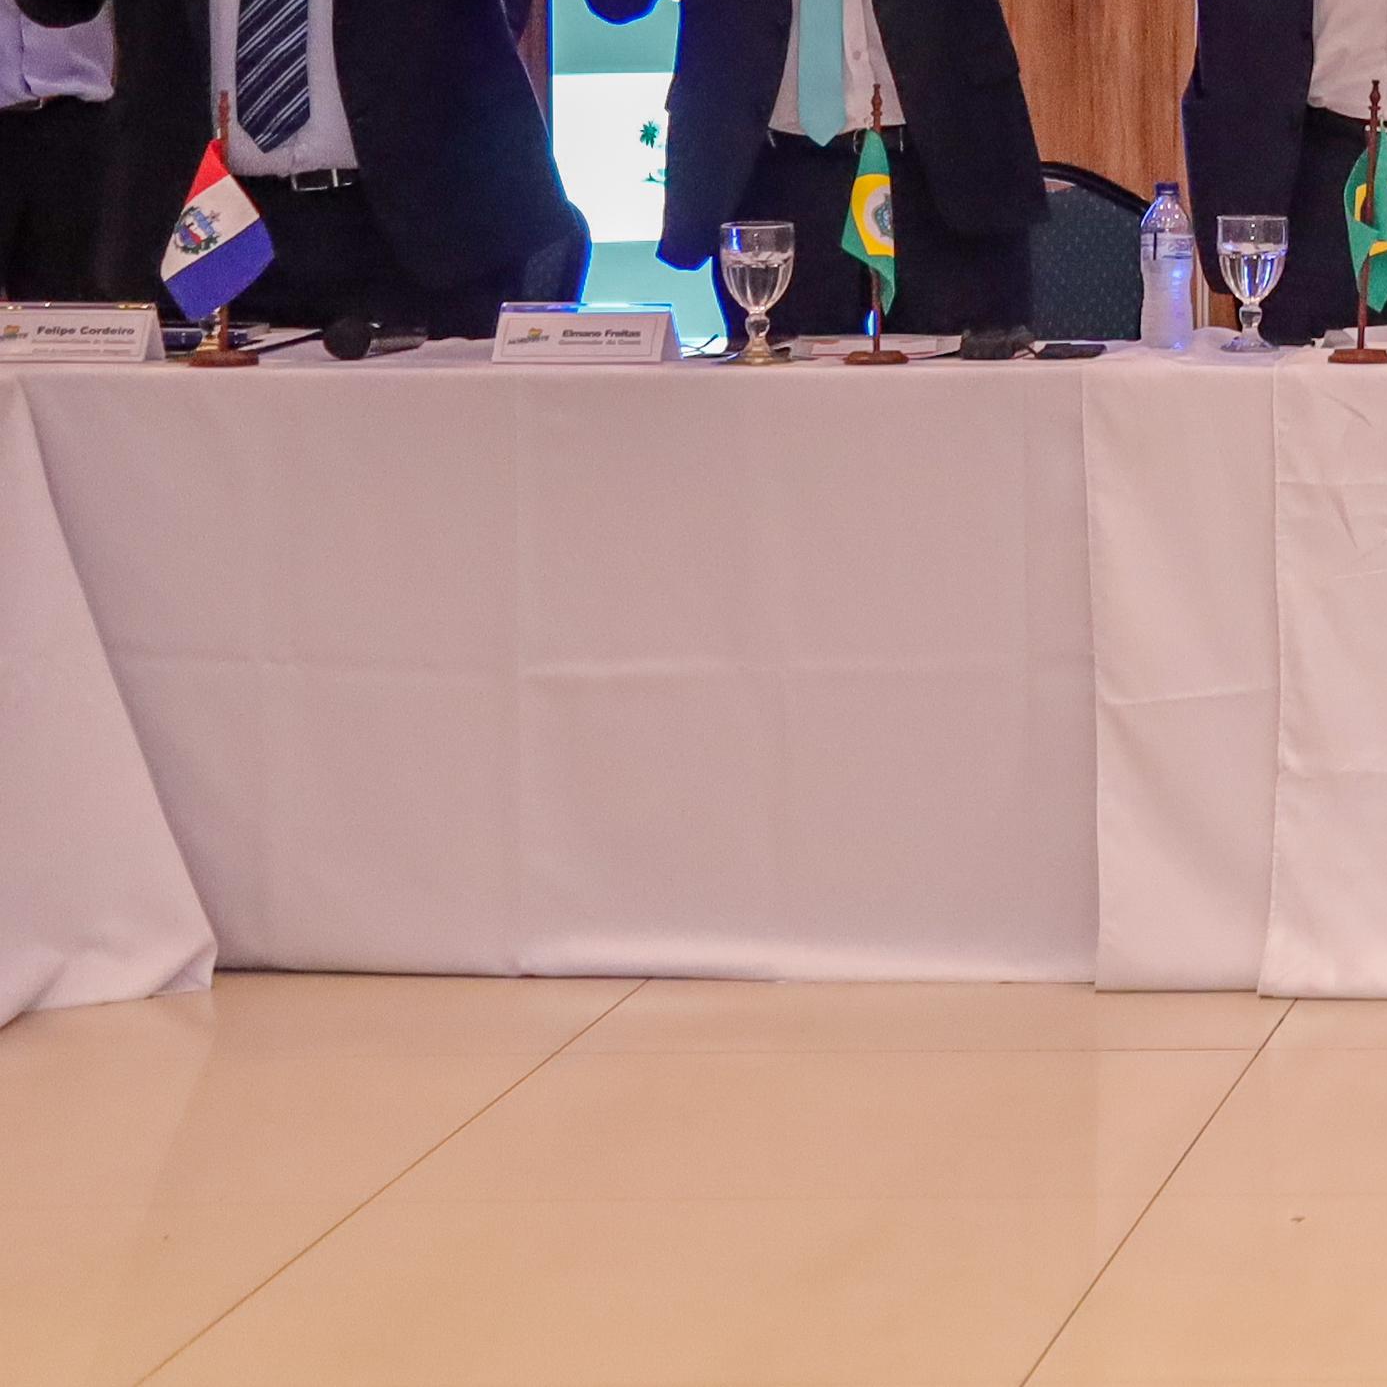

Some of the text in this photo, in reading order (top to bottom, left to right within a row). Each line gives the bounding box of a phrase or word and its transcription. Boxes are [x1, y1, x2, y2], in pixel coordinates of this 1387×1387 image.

[36, 325, 77, 336] Felipe
[80, 325, 136, 336] Cordeiro
[562, 329, 642, 338] Elmano Freitas
